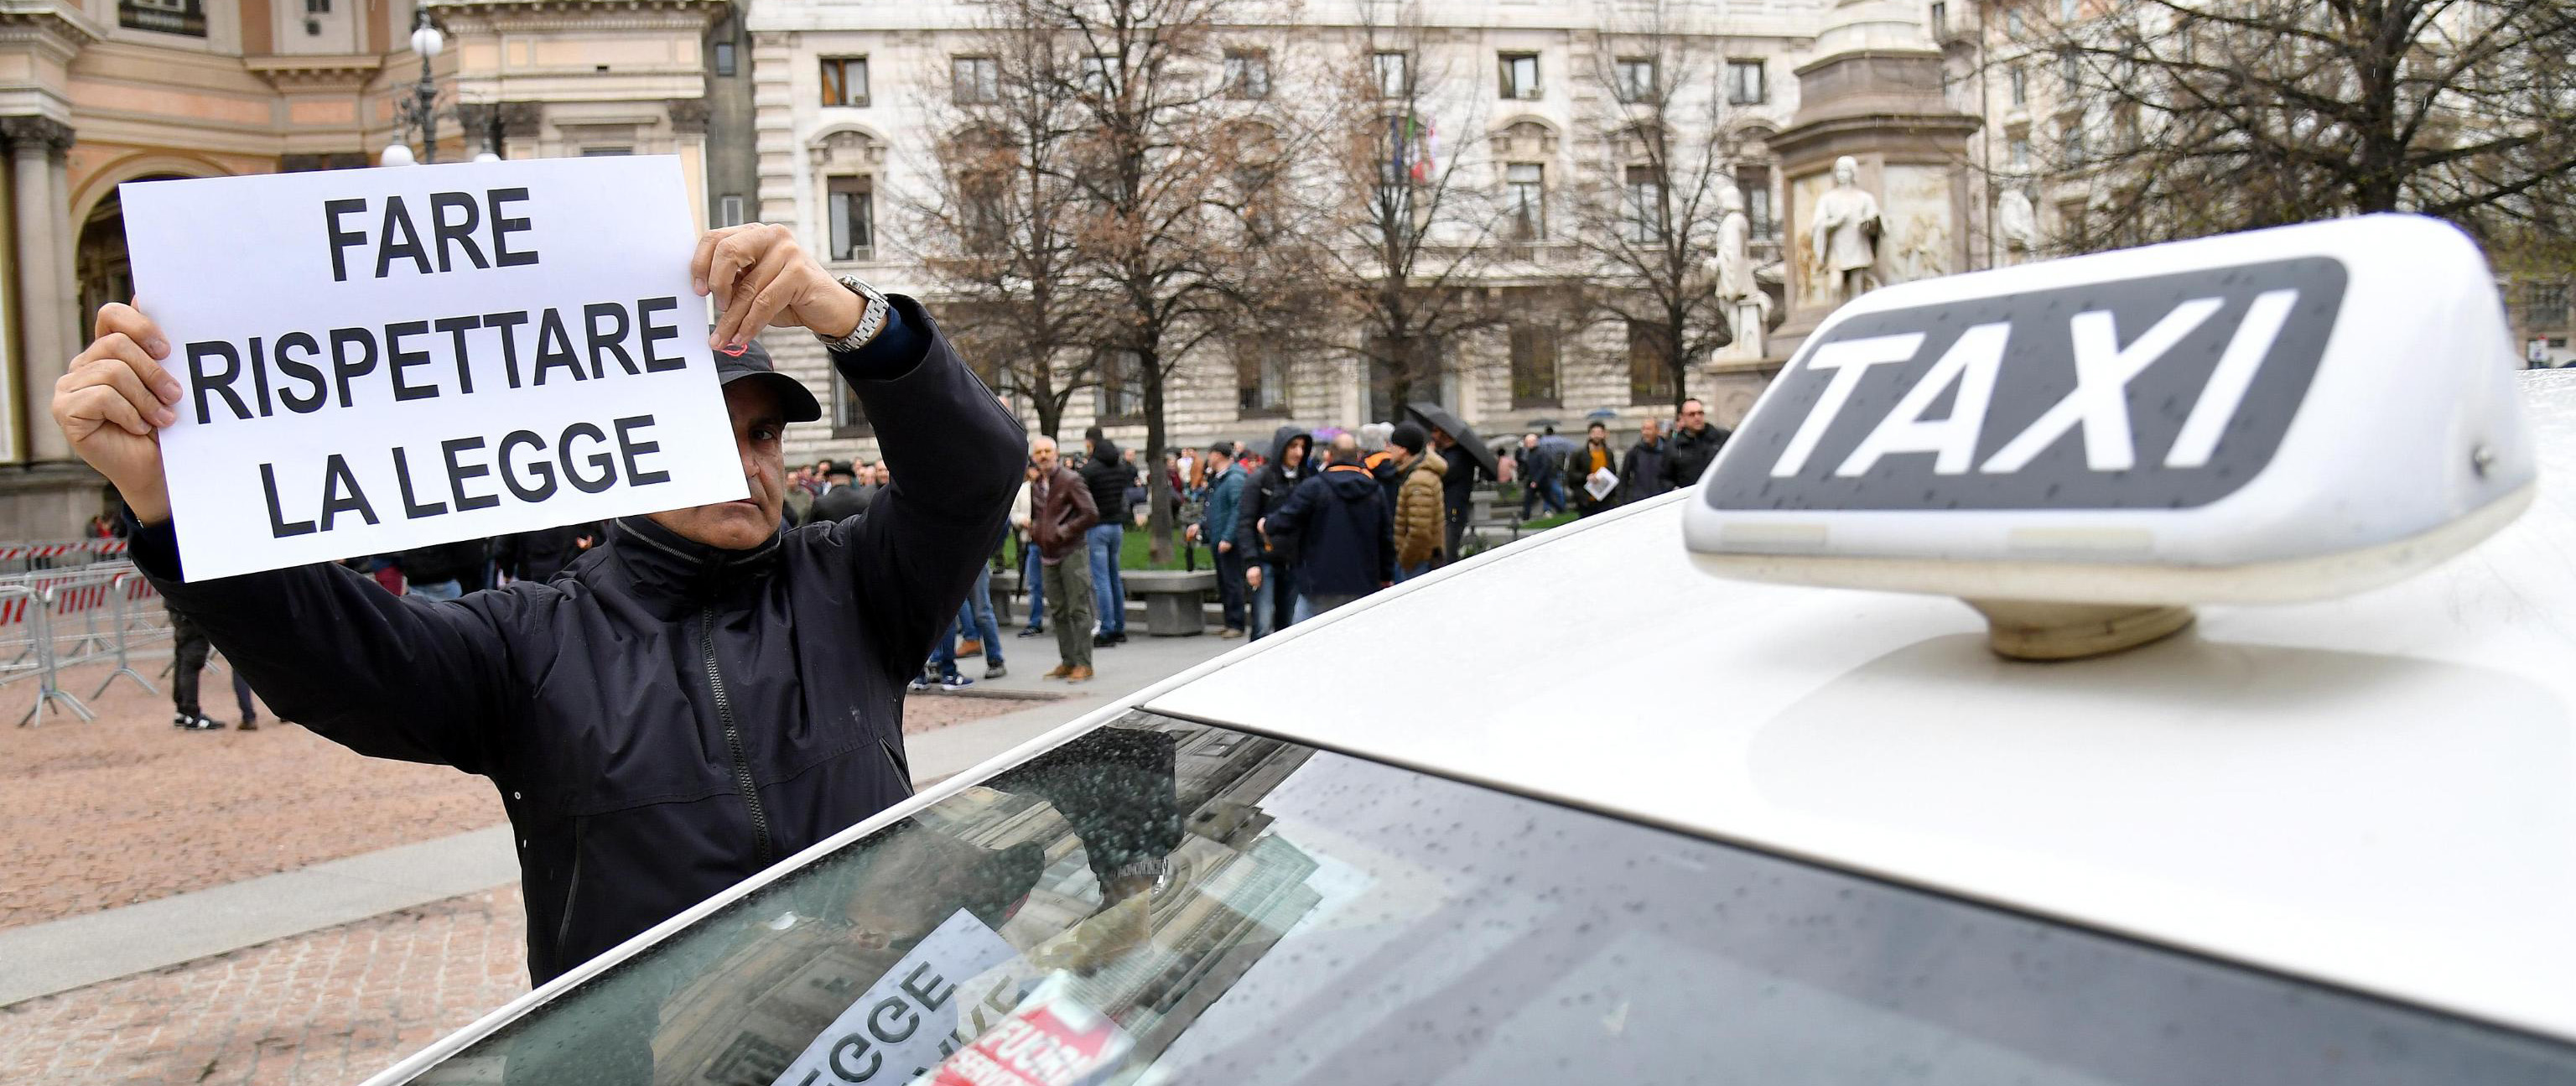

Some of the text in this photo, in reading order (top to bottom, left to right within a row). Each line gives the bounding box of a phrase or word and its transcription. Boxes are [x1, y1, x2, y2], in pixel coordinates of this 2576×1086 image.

[325, 187, 539, 283] FARE
[185, 296, 687, 425] RISPETTARE
[1770, 290, 2298, 477] TAXI
[259, 413, 671, 539] LA LEGGE
